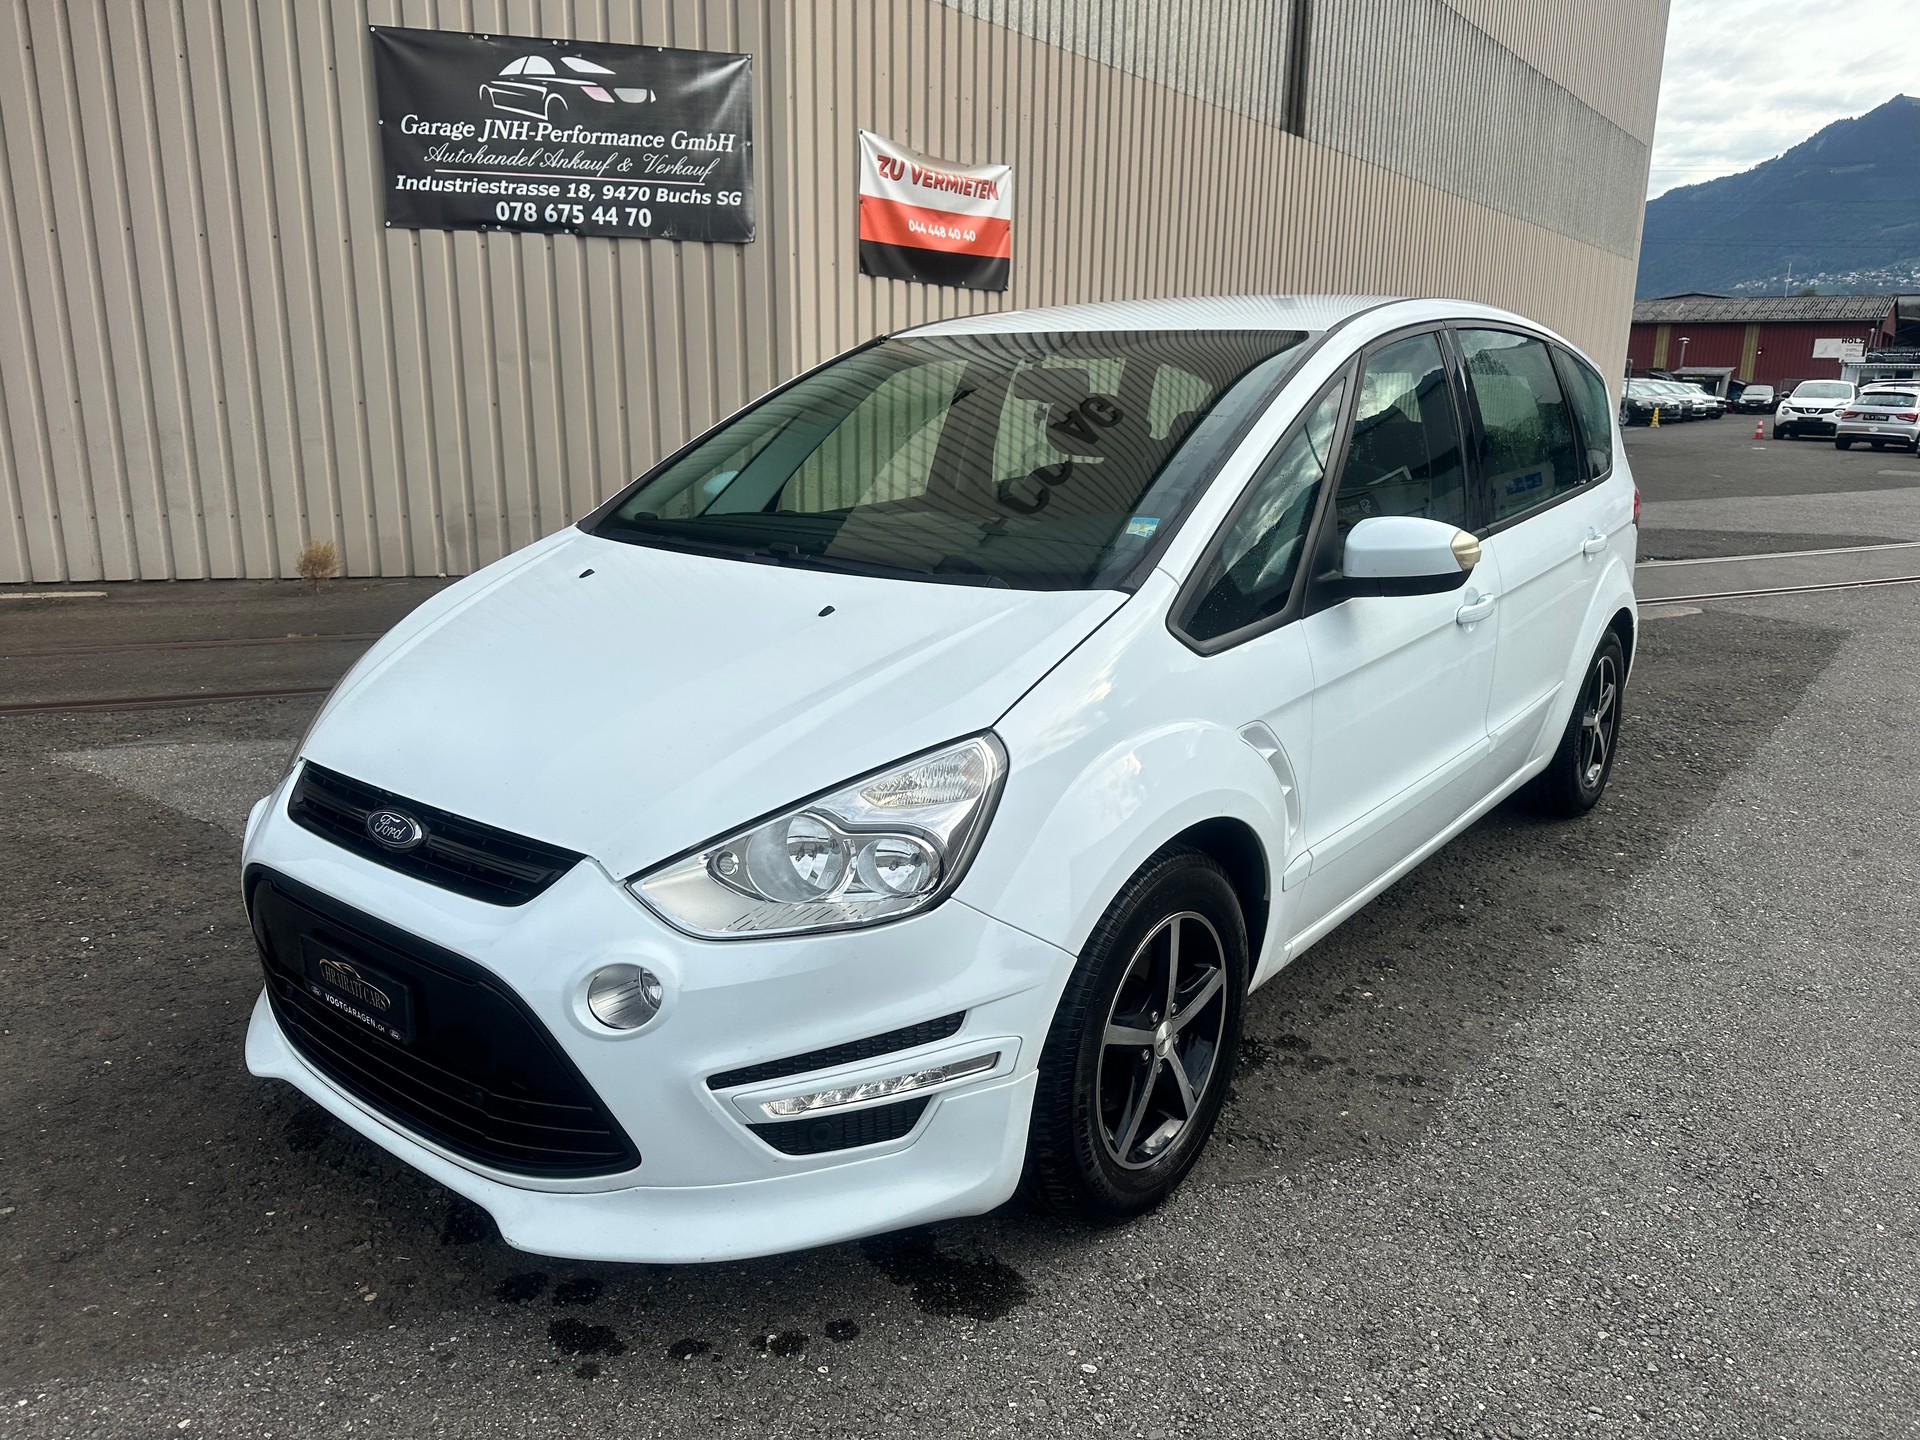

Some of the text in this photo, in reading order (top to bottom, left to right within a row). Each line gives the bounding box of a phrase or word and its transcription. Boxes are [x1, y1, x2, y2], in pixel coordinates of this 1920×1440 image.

[400, 114, 736, 153] Garage JNH-Performance GmbH
[423, 142, 721, 183] Autohandel Ankauf & Verkauf
[877, 154, 999, 201] ZU VERMIETEN
[395, 174, 743, 206] Industriestrasse 18, 9470 Buchs SG
[495, 200, 652, 228] 078 675 44 70
[908, 219, 976, 242] 044 448 40 40
[374, 814, 407, 840] Ford
[324, 992, 385, 1033] VOGTGARAGEN.CH
